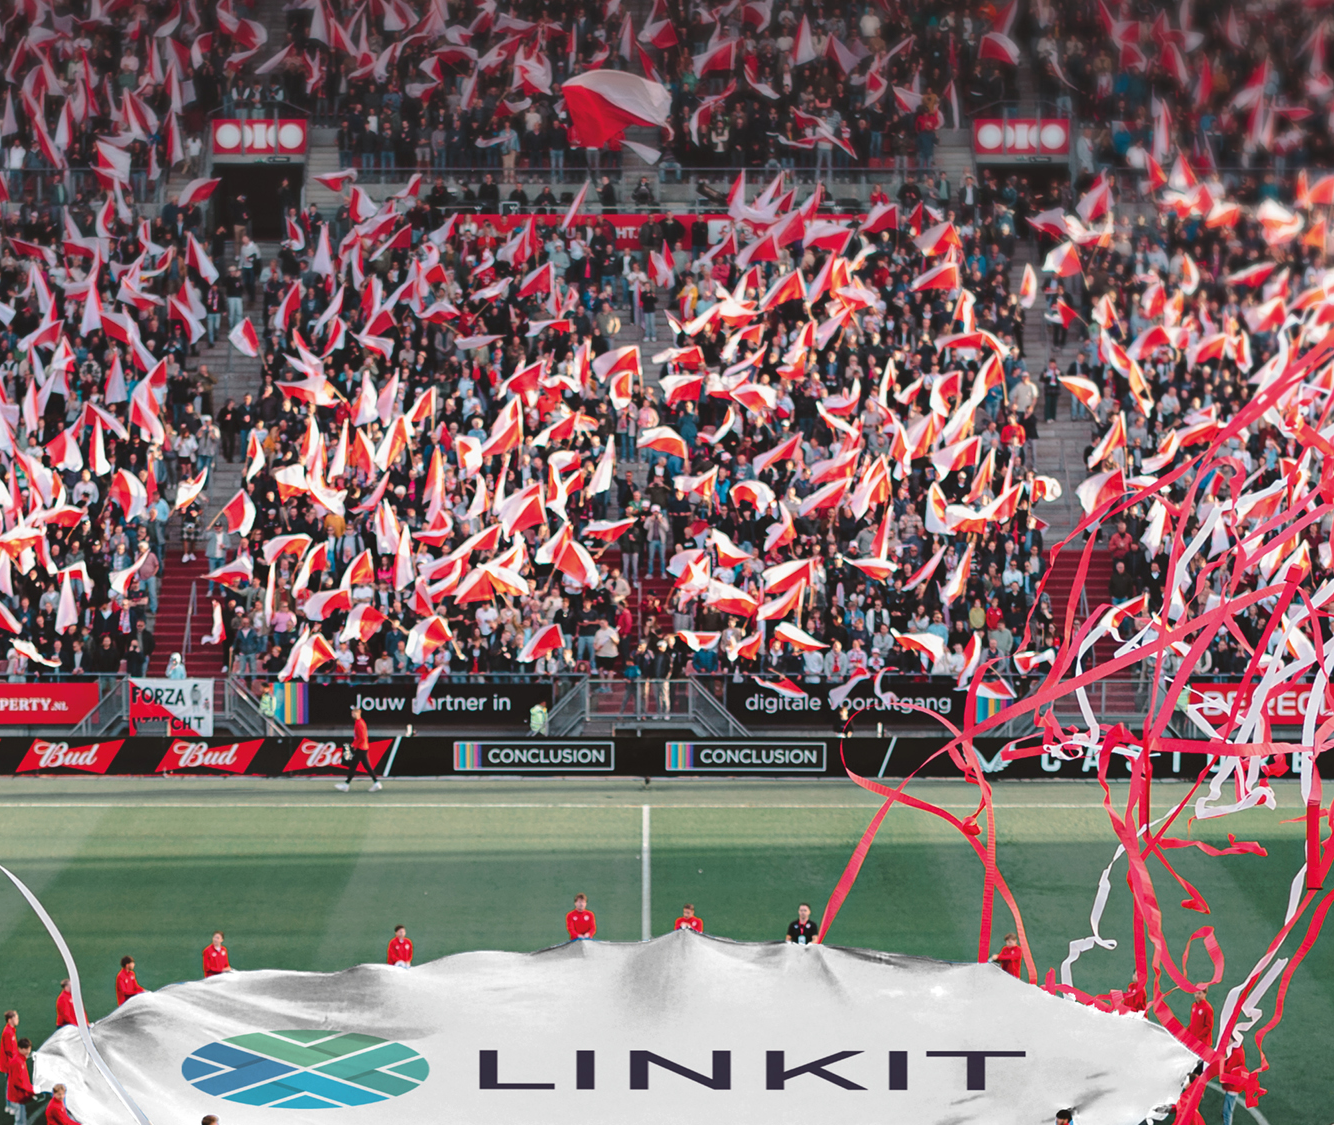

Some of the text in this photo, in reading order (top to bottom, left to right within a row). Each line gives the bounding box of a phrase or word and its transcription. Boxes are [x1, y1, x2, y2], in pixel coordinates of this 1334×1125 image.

[131, 686, 186, 706] FORZA
[352, 693, 511, 716] Jouw artner in
[746, 694, 821, 714] digitale
[131, 716, 205, 731] UCHT
[33, 741, 97, 768] Bud
[173, 741, 237, 768] Bud
[301, 741, 346, 768] Bu
[488, 749, 606, 764] CONCLUSION
[700, 749, 818, 764] CONCLUSION
[478, 1049, 1028, 1091] LINKIT
